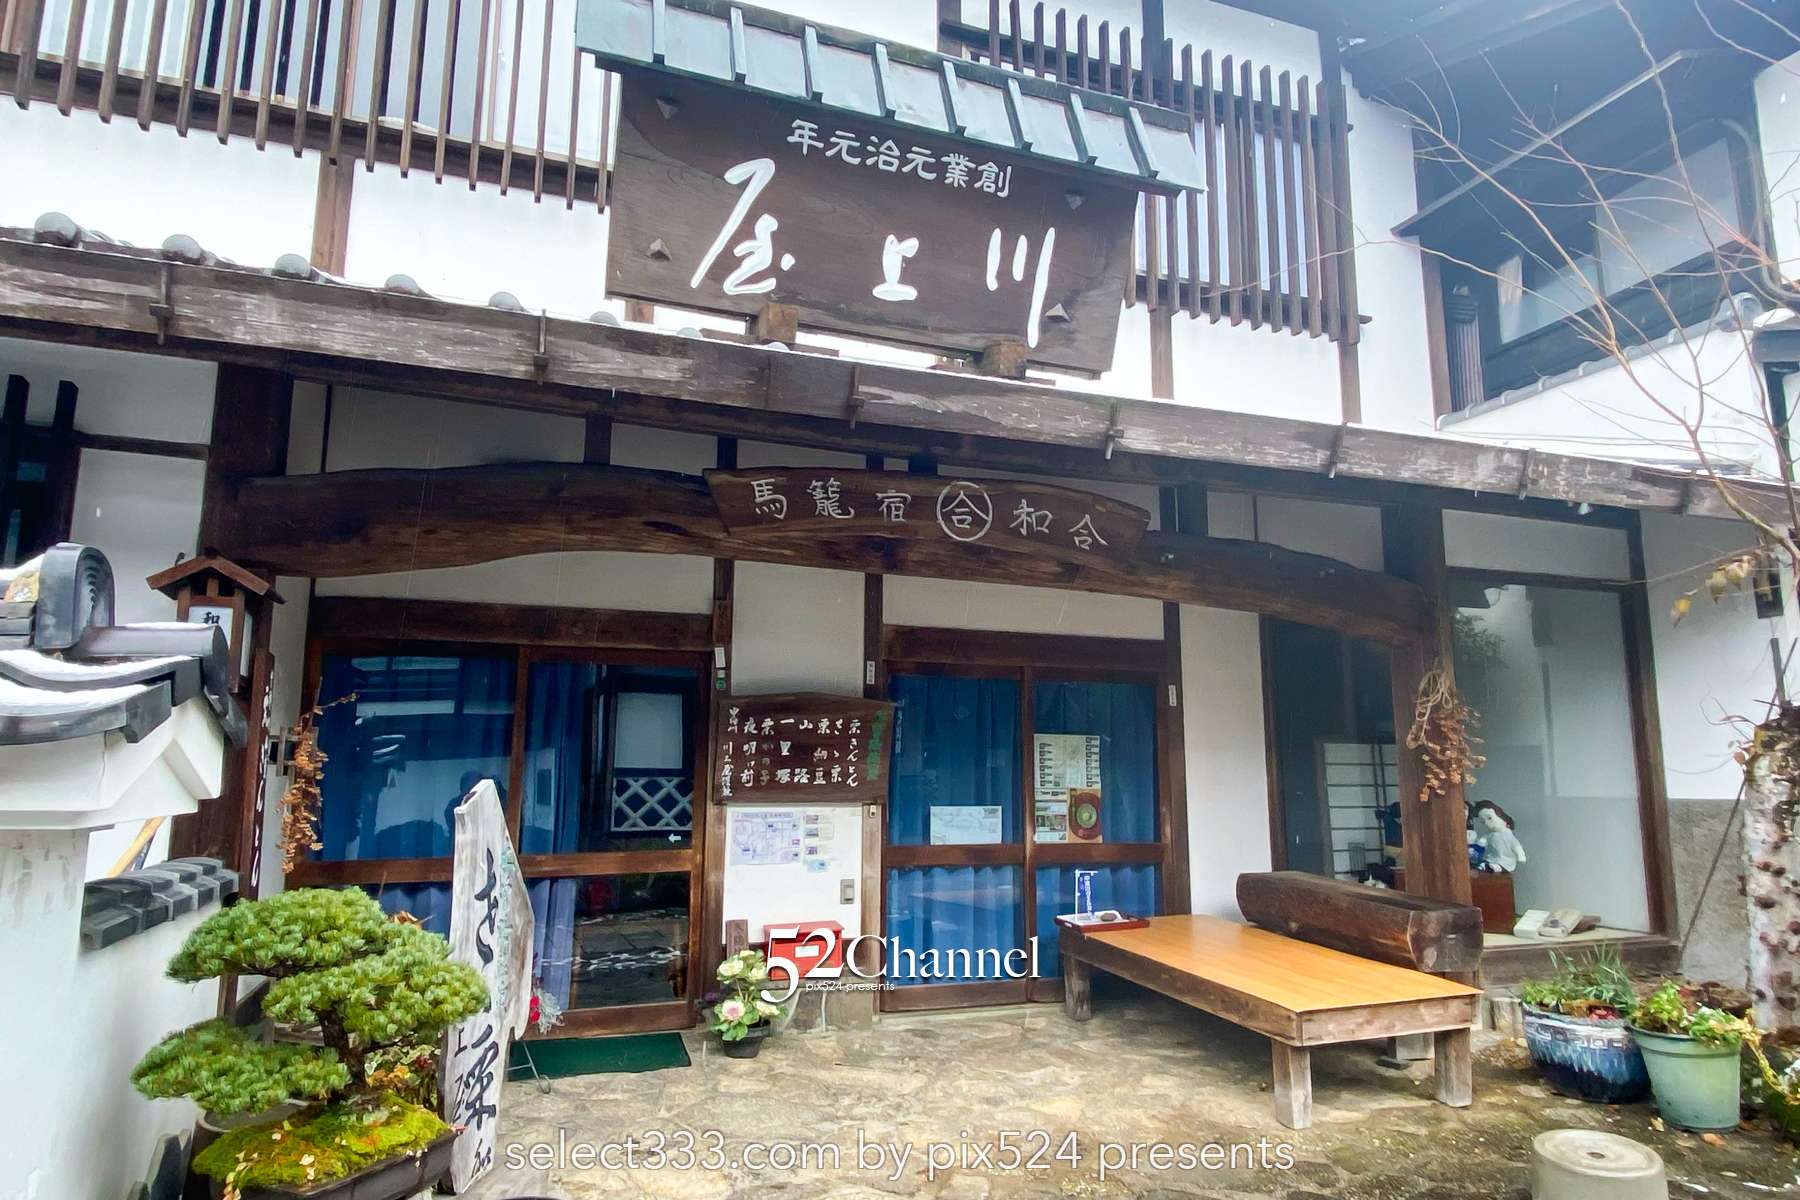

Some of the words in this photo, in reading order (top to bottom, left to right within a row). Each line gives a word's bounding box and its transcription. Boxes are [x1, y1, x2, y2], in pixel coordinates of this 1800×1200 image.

[786, 118, 1013, 198] 創業元治元年
[690, 157, 1056, 349] 川上屋
